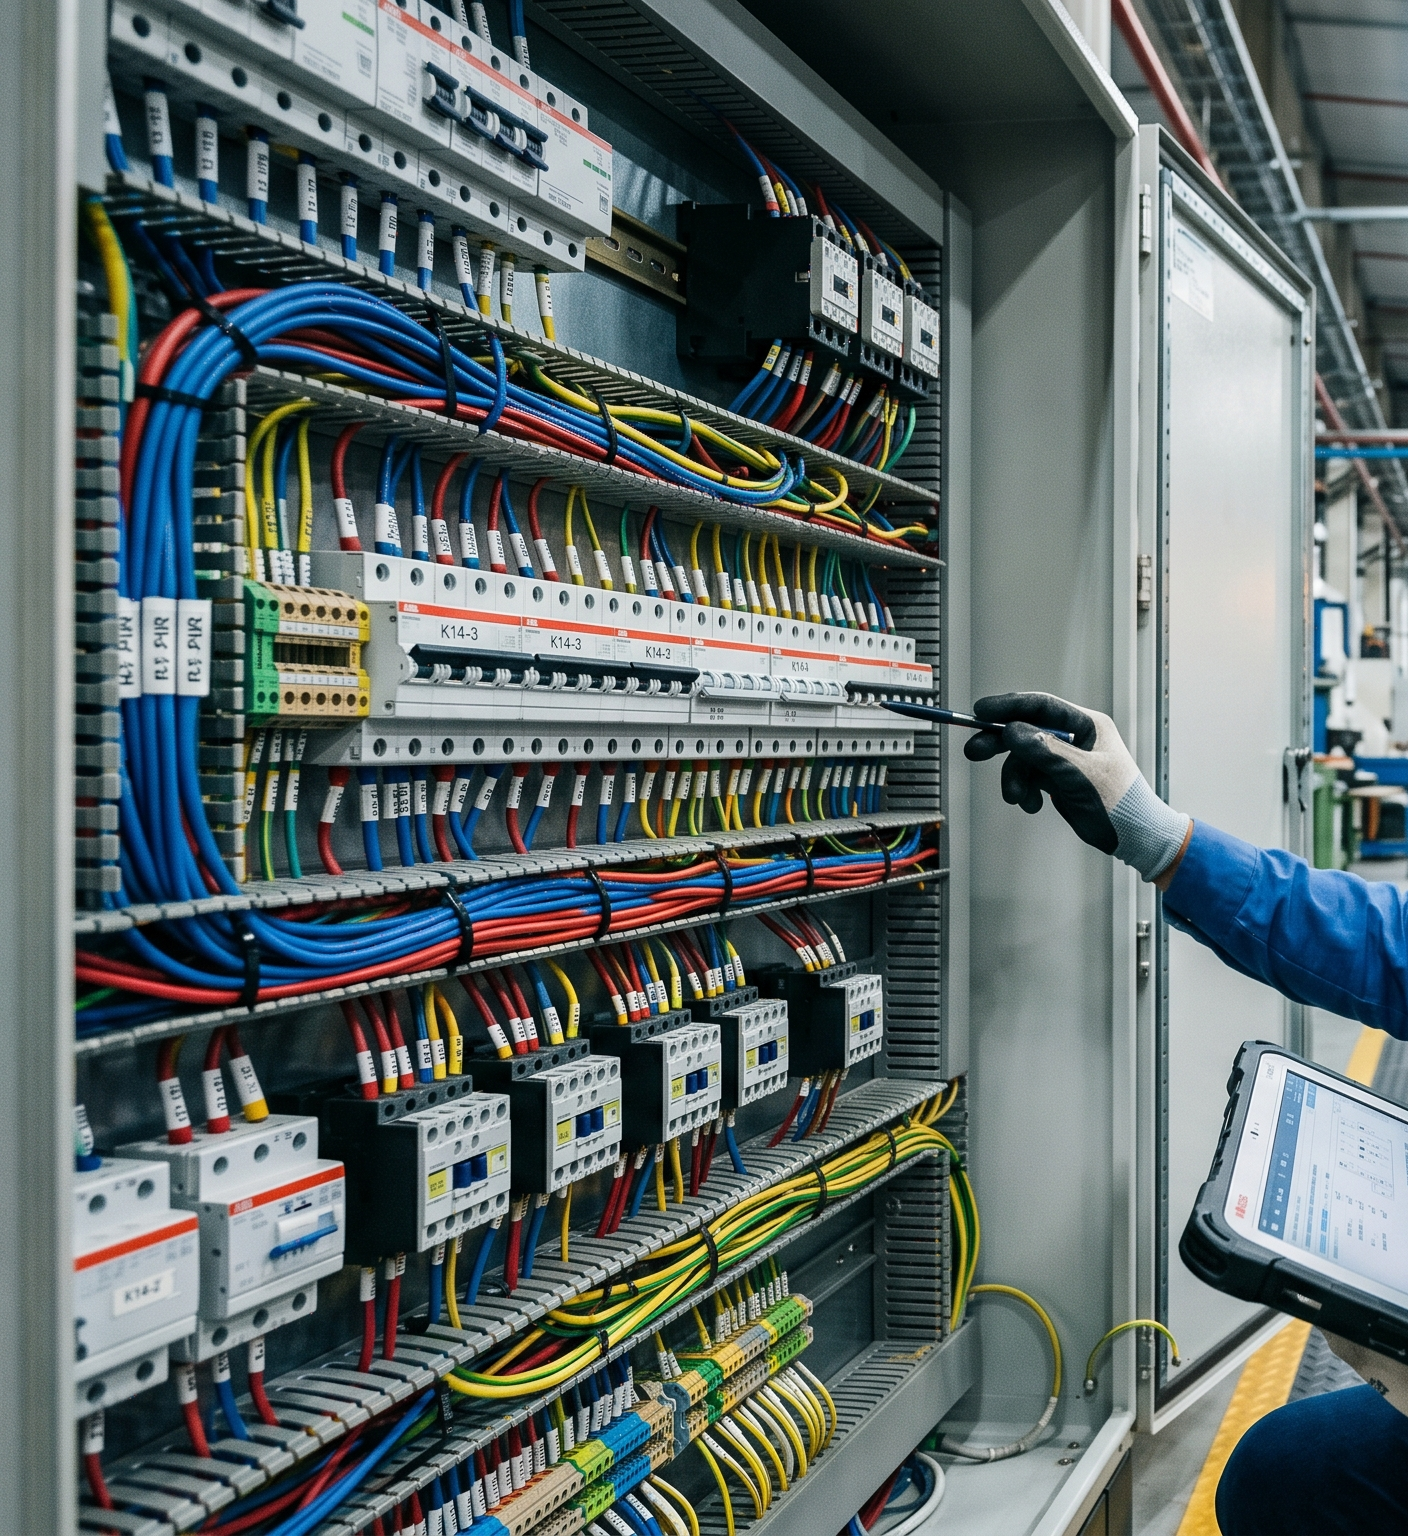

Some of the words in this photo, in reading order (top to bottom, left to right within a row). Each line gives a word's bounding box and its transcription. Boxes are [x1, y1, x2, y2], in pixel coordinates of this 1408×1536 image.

[440, 624, 479, 641] K14-3
[550, 635, 582, 651] K14-3
[645, 646, 671, 660] K14-3
